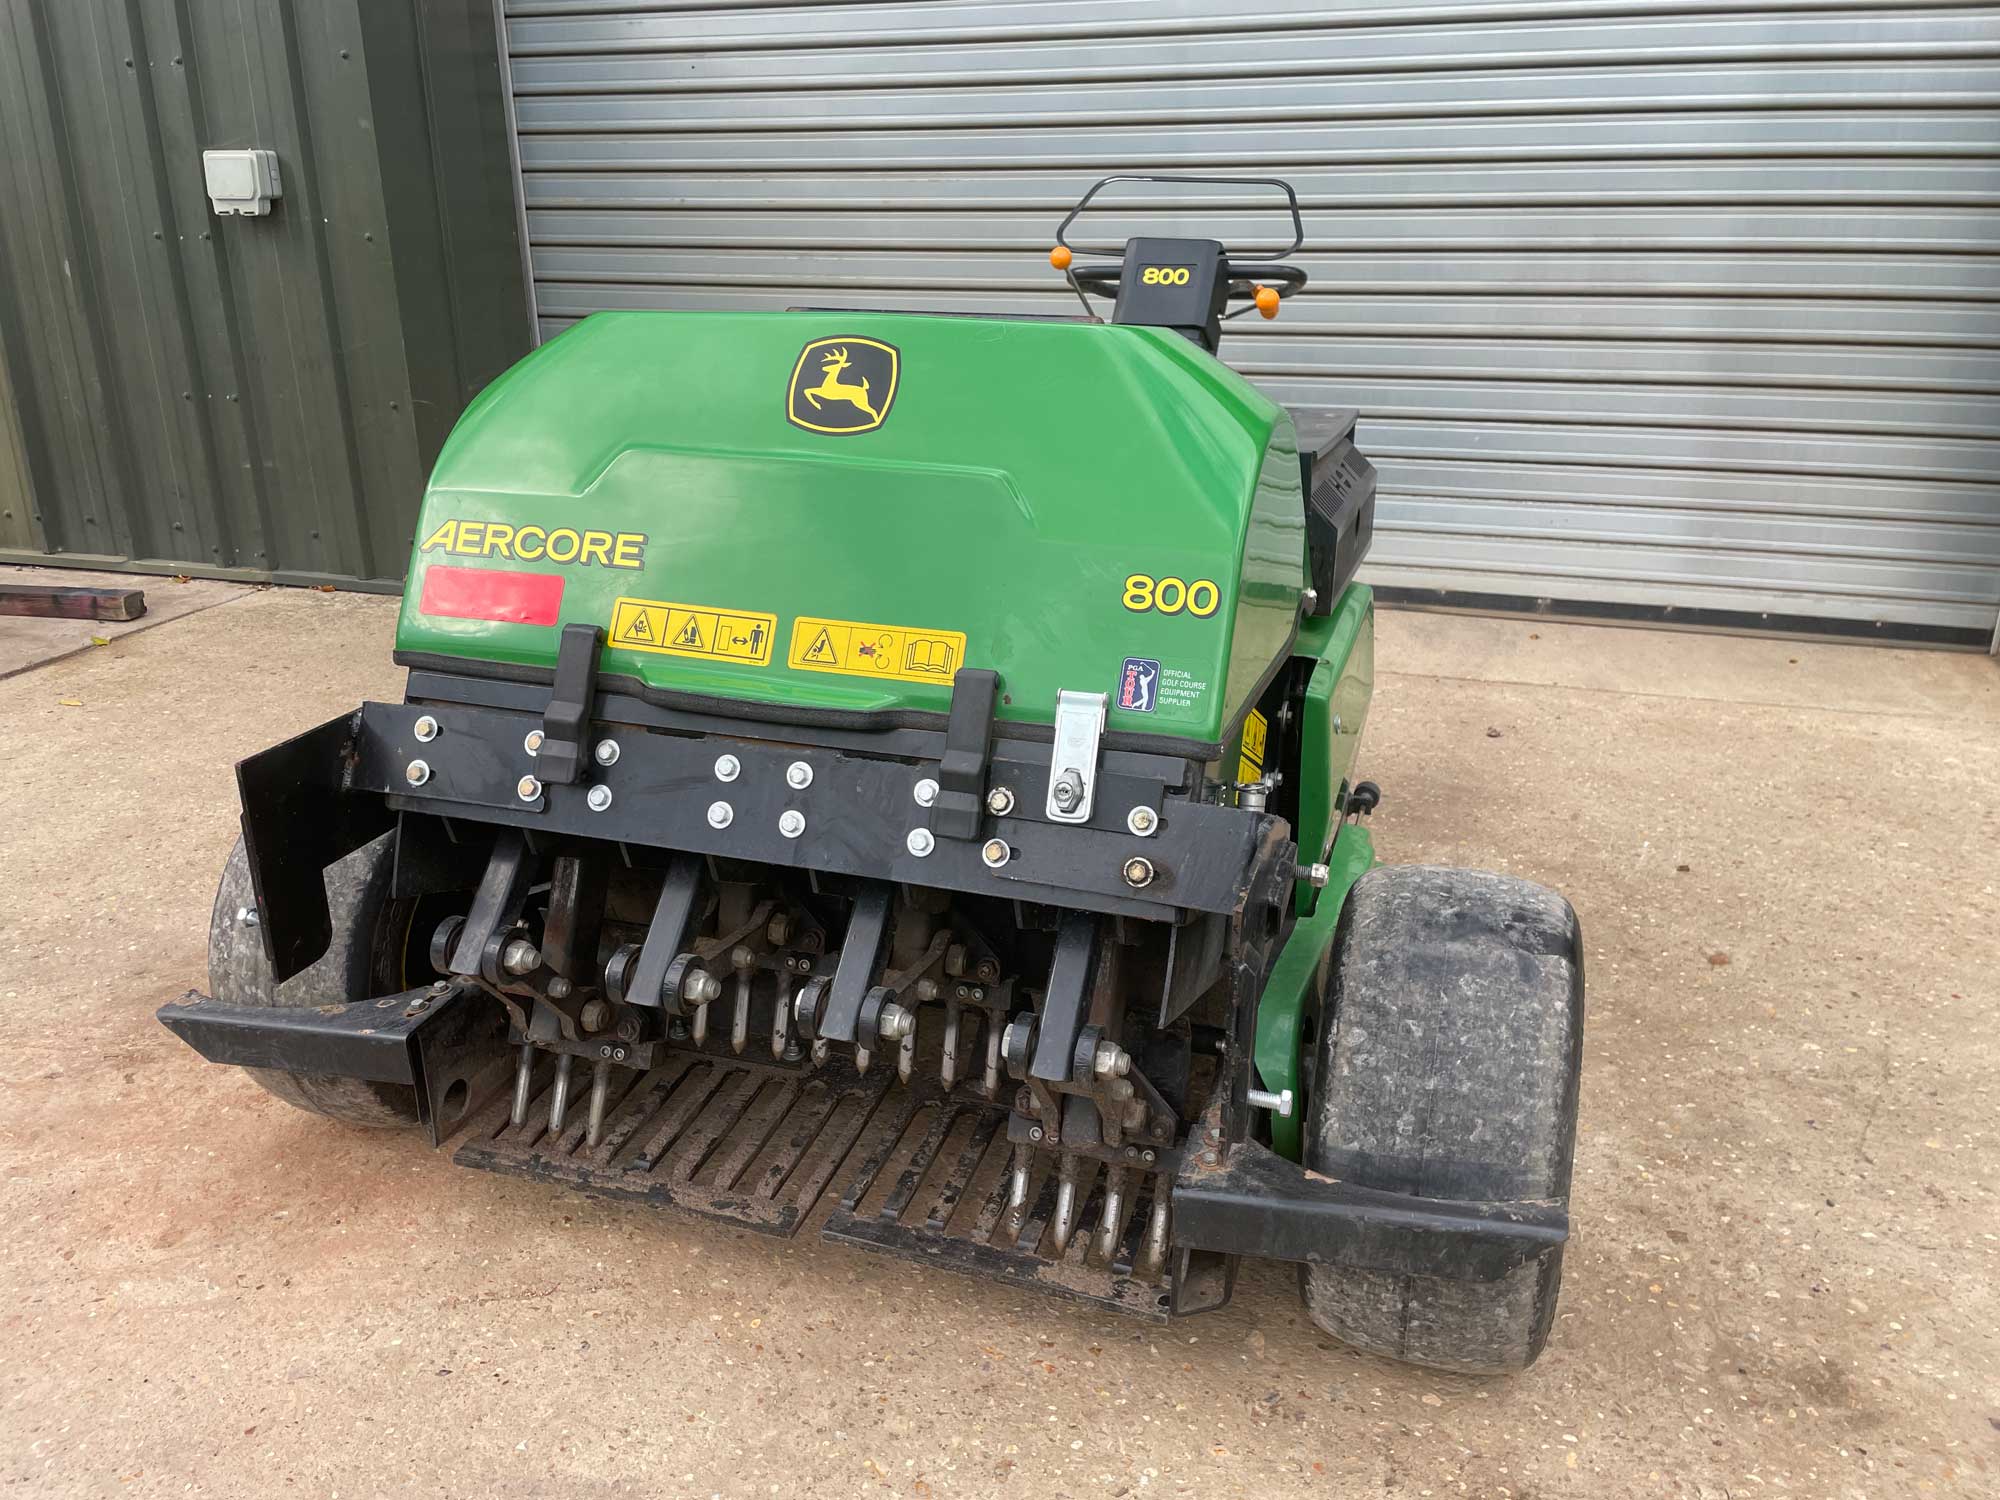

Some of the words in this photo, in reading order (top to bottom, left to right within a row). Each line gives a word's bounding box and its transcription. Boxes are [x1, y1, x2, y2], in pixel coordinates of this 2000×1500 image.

[1142, 267, 1190, 285] 800
[420, 519, 647, 570] AERCORE
[1122, 574, 1221, 618] 800
[1127, 664, 1144, 672] PGA
[1163, 669, 1191, 679] OFFICIAL
[1122, 670, 1137, 707] TOUR
[1161, 678, 1179, 687] GOLF
[1179, 680, 1207, 690] COURSE
[1160, 688, 1200, 698] EQUIPMENT
[1159, 697, 1191, 707] SUPPLIER
